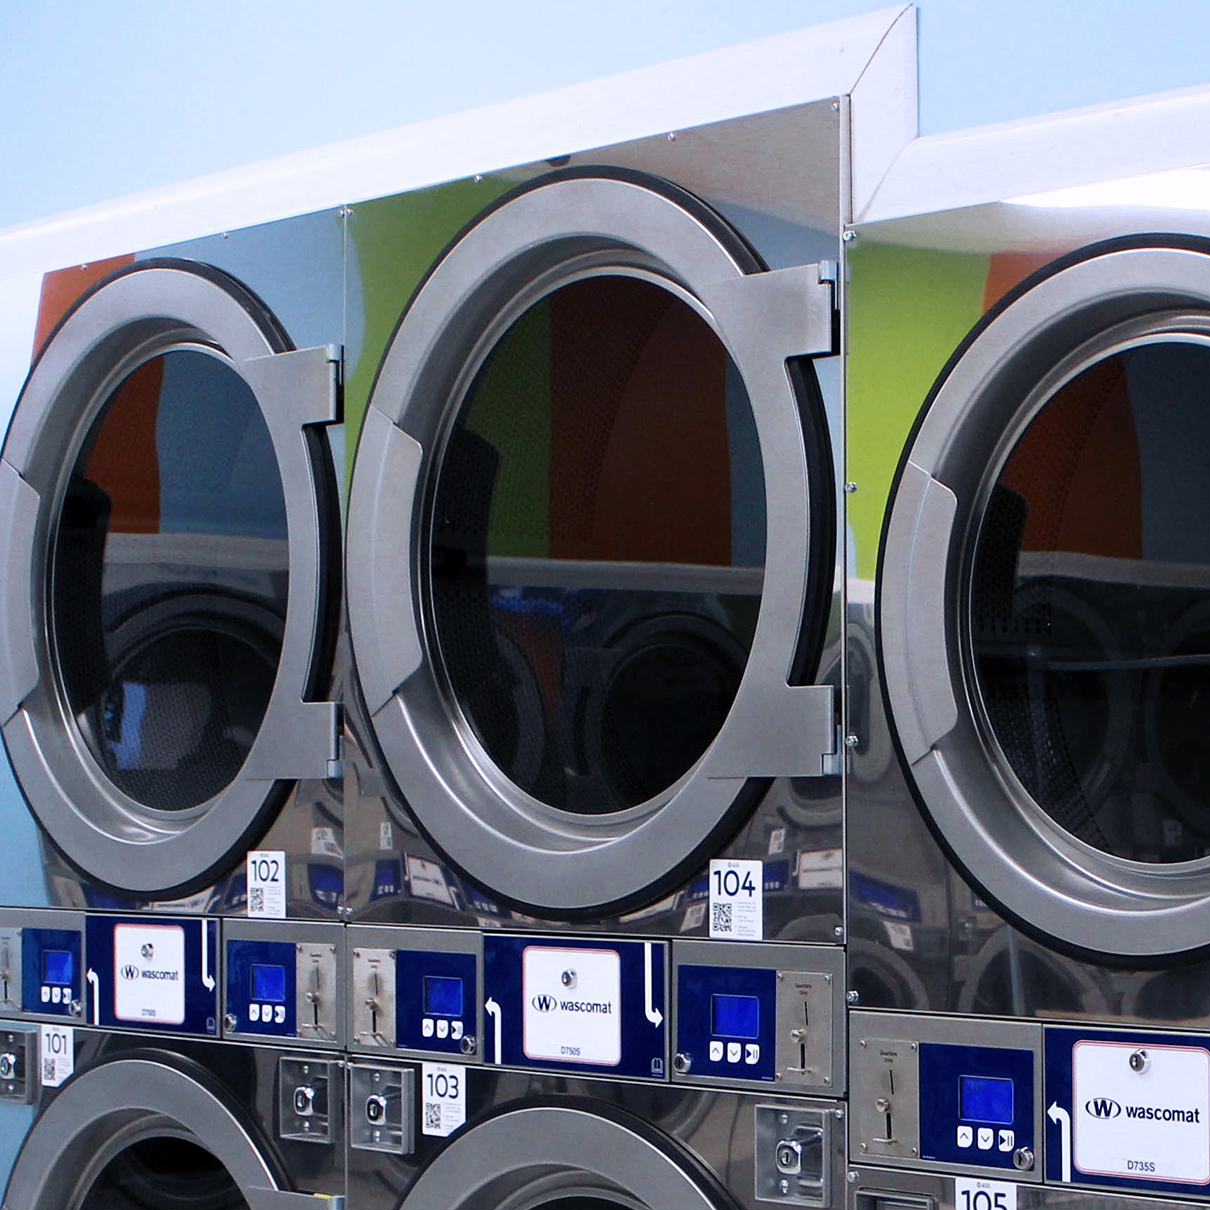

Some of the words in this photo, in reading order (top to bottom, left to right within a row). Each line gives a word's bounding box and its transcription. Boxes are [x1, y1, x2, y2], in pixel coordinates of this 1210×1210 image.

[250, 859, 280, 882] 102
[713, 869, 756, 898] 104
[141, 969, 179, 981] wascomat
[559, 1000, 612, 1014] wascomat
[45, 1032, 67, 1055] 101
[426, 1073, 459, 1099] 103
[1125, 1106, 1201, 1124] wascomat
[1127, 1159, 1156, 1173] D735S
